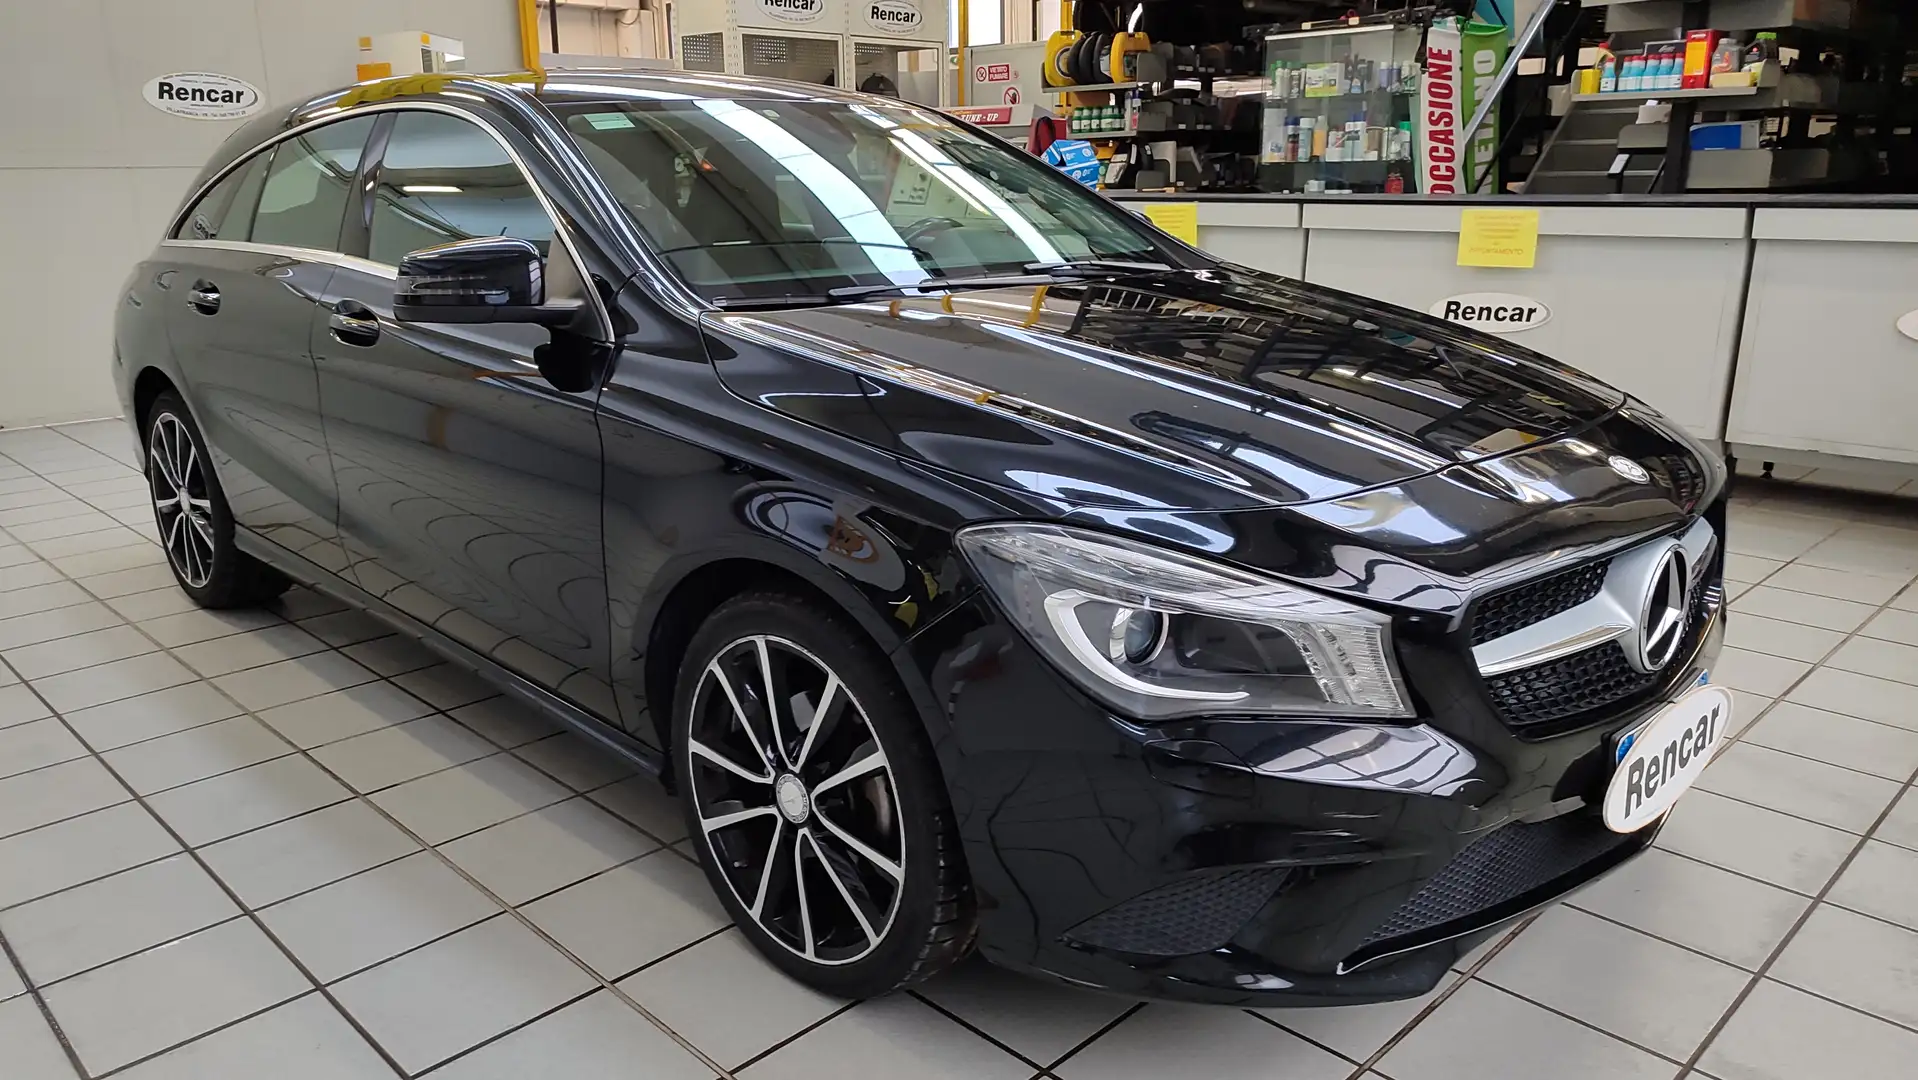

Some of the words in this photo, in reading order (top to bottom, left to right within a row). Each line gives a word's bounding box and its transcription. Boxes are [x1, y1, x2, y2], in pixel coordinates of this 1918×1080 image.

[871, 6, 915, 23] Rencar
[158, 82, 244, 104] Rencar
[1427, 47, 1456, 195] OCCASIONE
[1443, 300, 1537, 323] Rencar
[1624, 703, 1721, 819] Rencar
